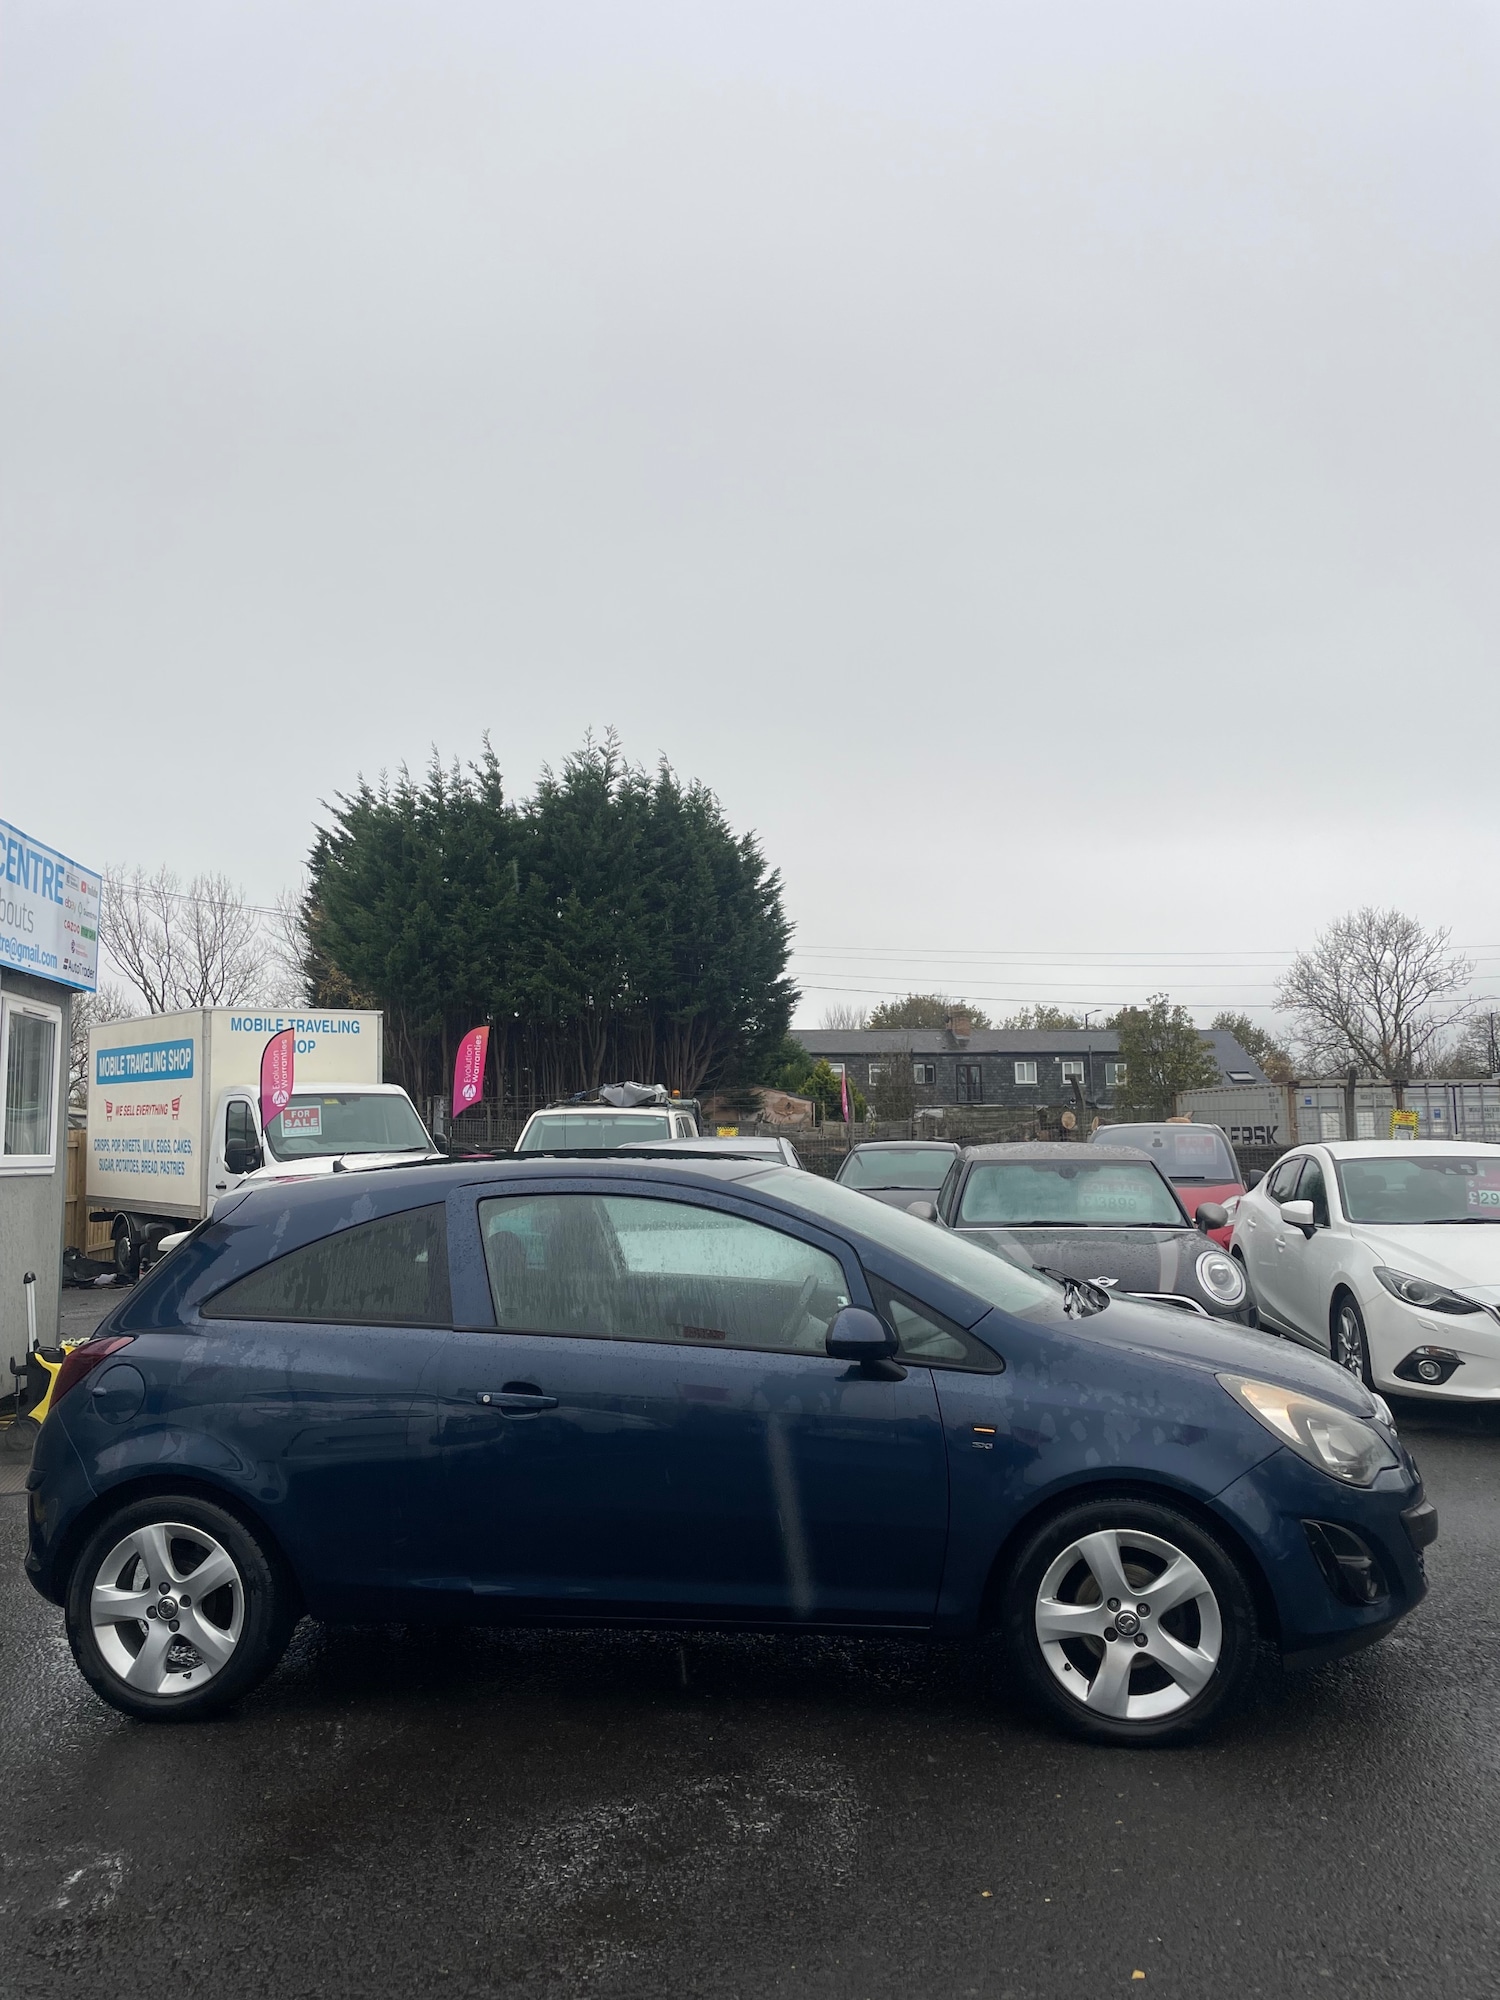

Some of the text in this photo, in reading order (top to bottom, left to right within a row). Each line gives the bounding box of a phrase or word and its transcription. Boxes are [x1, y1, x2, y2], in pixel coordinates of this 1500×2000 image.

[230, 1017, 361, 1034] MOBILE TRAVELING
[98, 1047, 192, 1077] MOBILE TRAVELING SHOP
[280, 1039, 288, 1089] Warranties
[463, 1044, 473, 1083] Evolution
[472, 1034, 482, 1083] Warranties
[272, 1050, 280, 1090] Evolution
[115, 1103, 169, 1116] WE SELL EVERYTHING
[291, 1110, 310, 1118] FOR
[284, 1117, 319, 1128] SALE
[173, 1139, 193, 1156] CAKES,
[160, 1161, 185, 1176] PASTRIES
